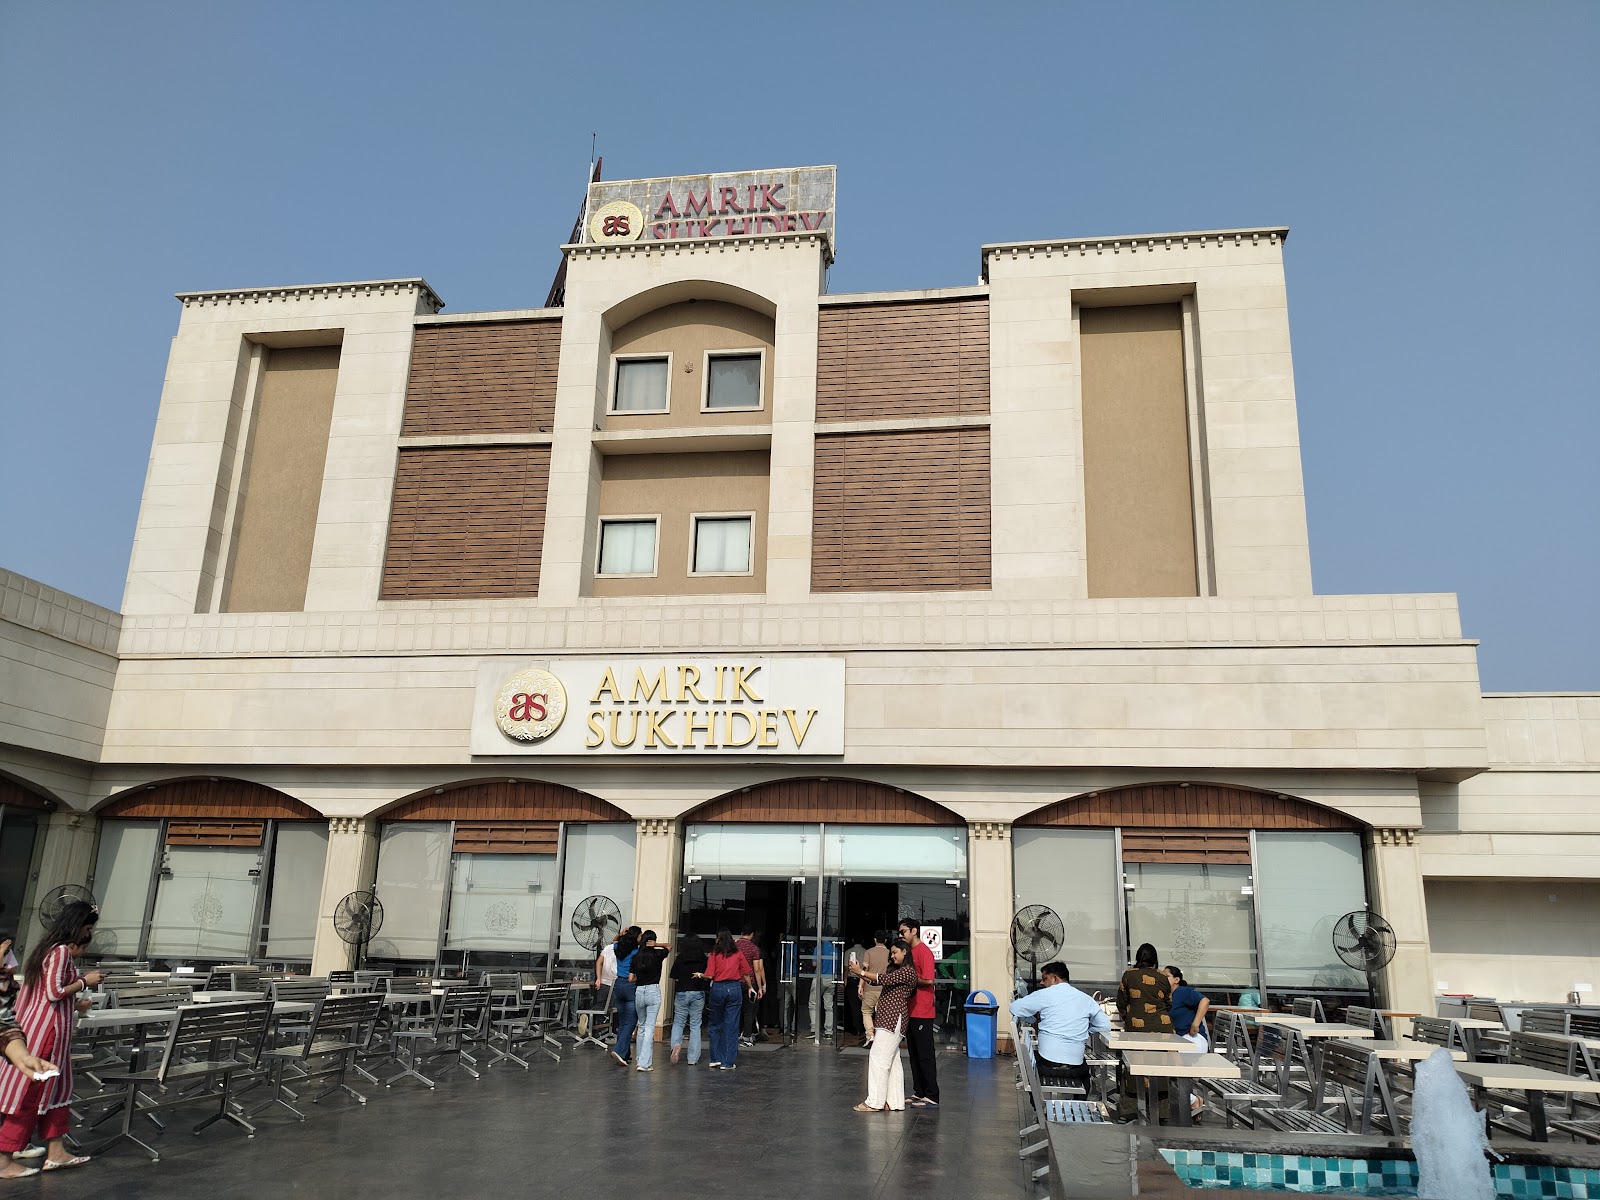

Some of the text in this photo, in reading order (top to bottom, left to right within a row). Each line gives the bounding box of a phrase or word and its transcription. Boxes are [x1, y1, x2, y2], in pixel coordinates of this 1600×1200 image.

[655, 183, 786, 218] AMRIK
[652, 212, 826, 239] SUKHDEV
[589, 665, 764, 705] AMRIK
[508, 692, 548, 722] as
[585, 708, 818, 750] SUKHDEV
